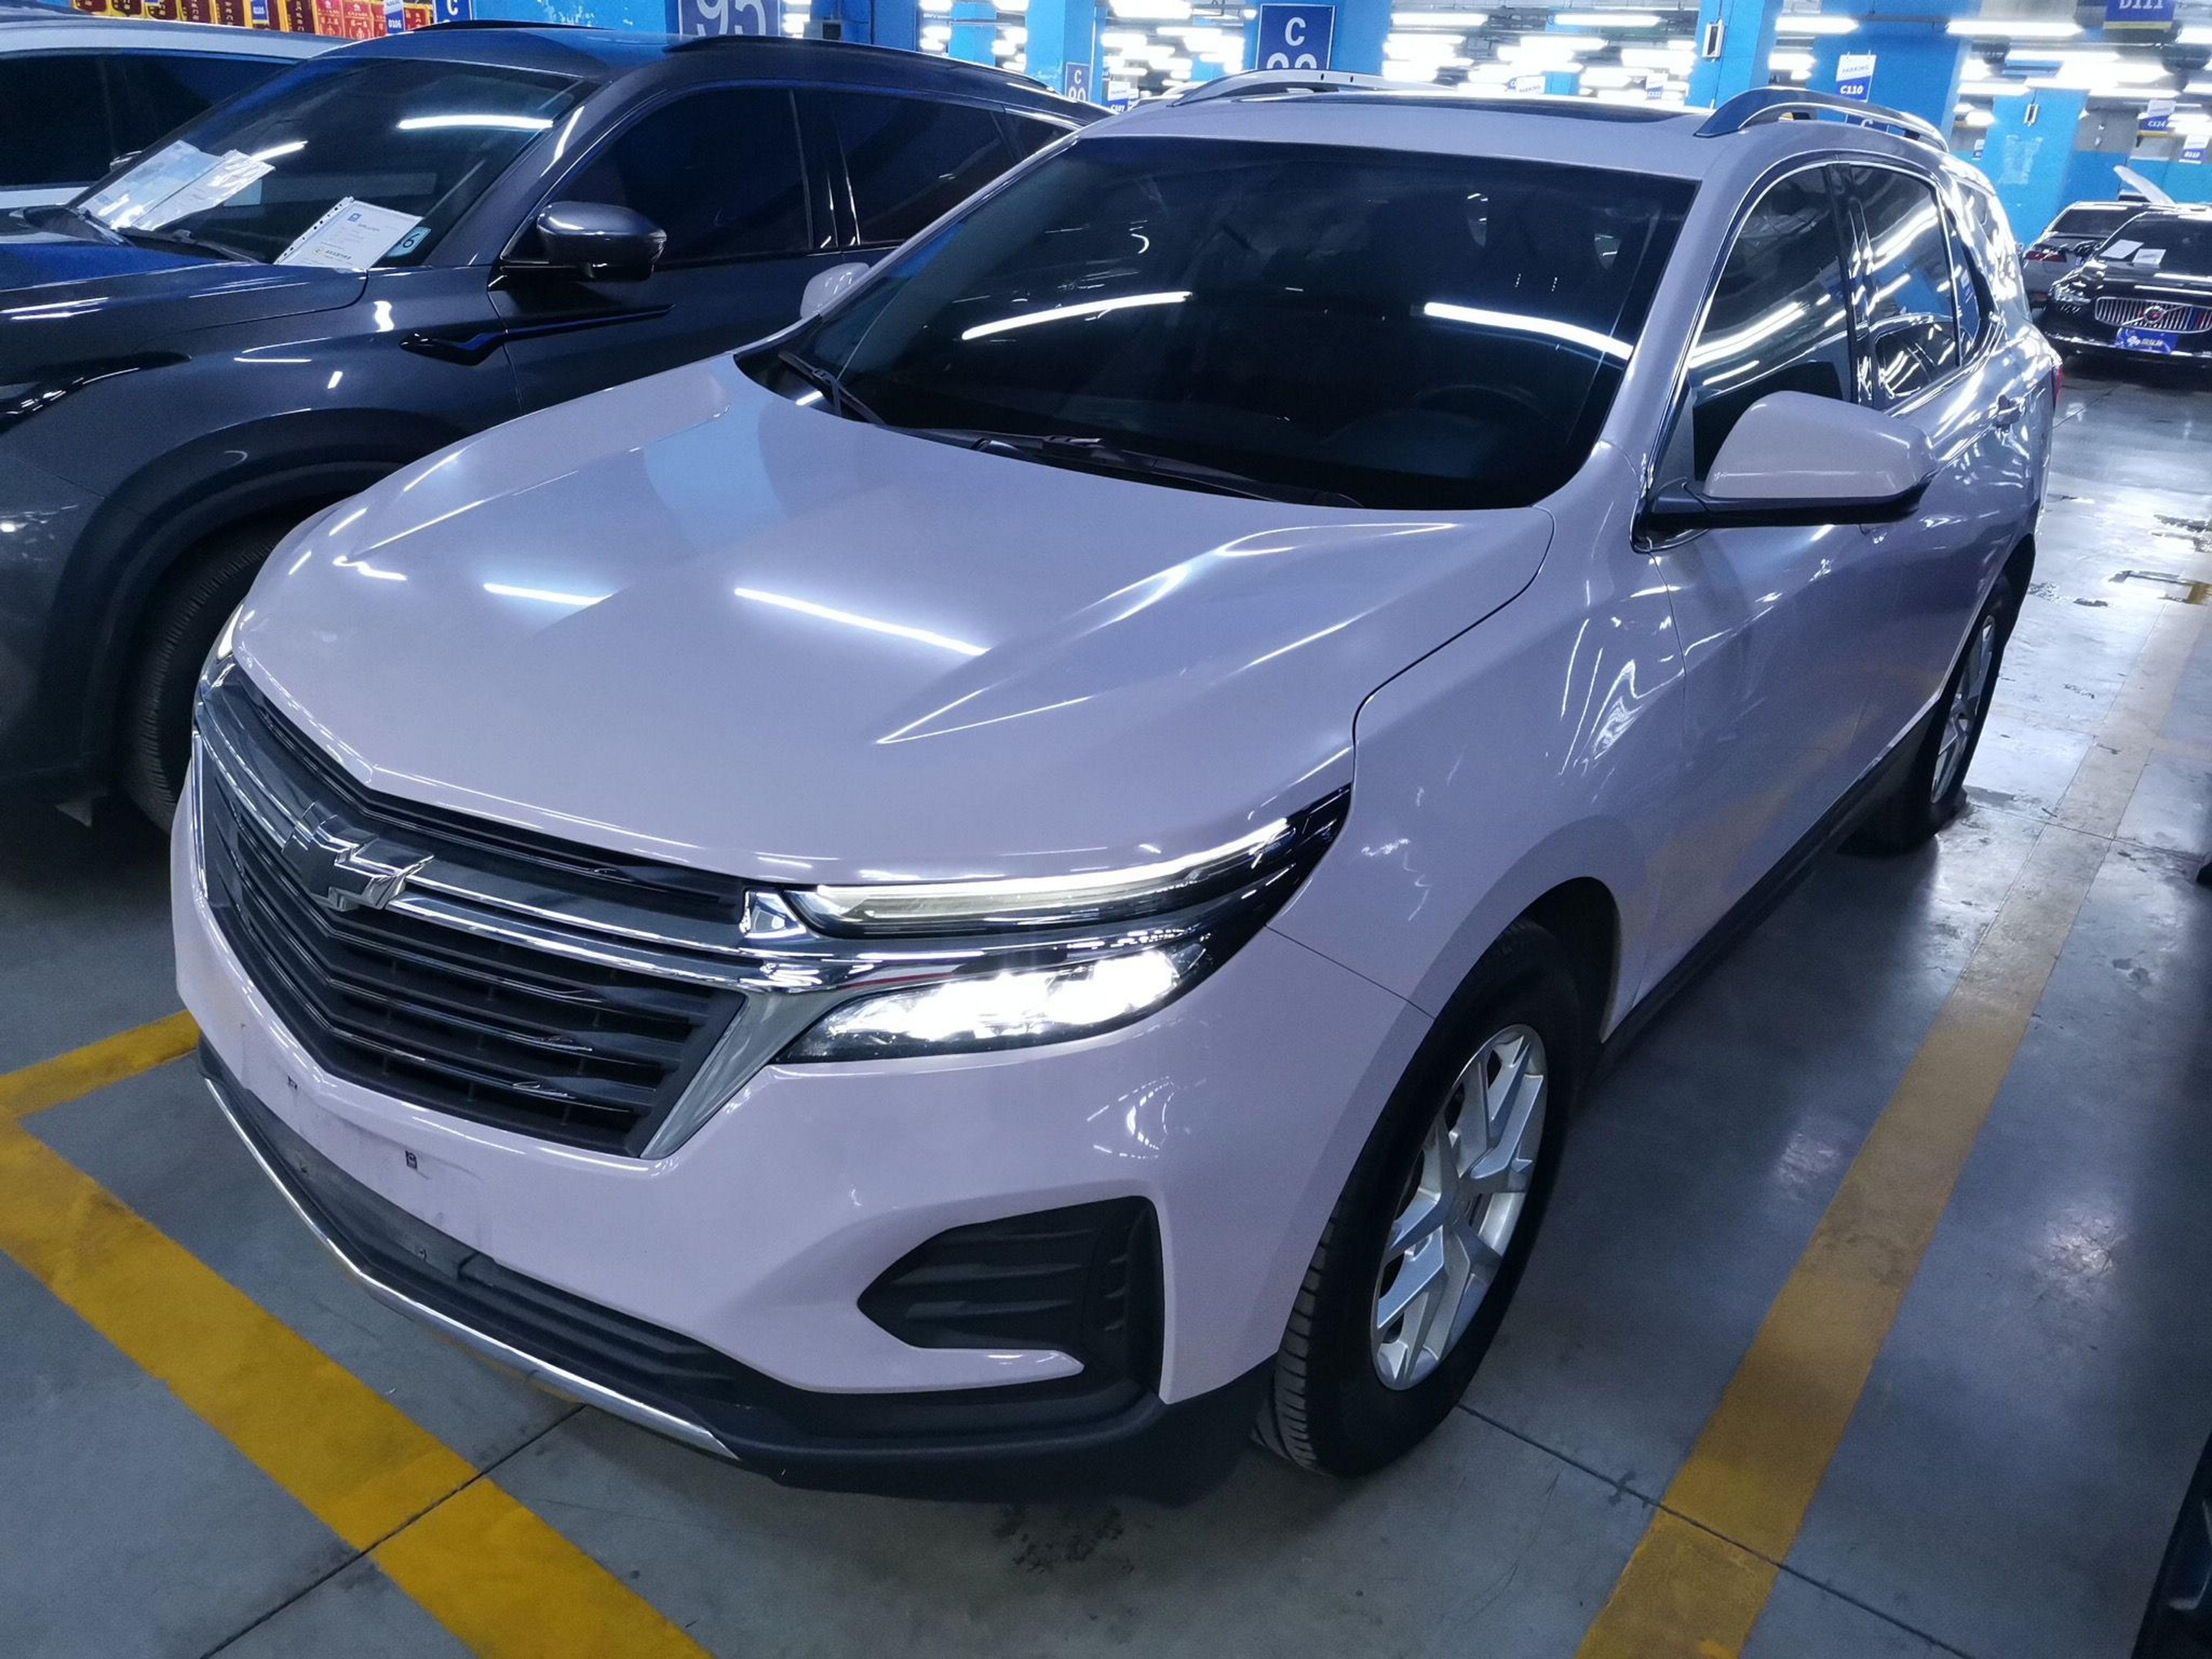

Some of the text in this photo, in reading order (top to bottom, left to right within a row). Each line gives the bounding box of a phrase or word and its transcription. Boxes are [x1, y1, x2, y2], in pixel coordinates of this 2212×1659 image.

[1285, 17, 1306, 46] C
[1074, 70, 1082, 84] C
[1840, 85, 1863, 95] C110
